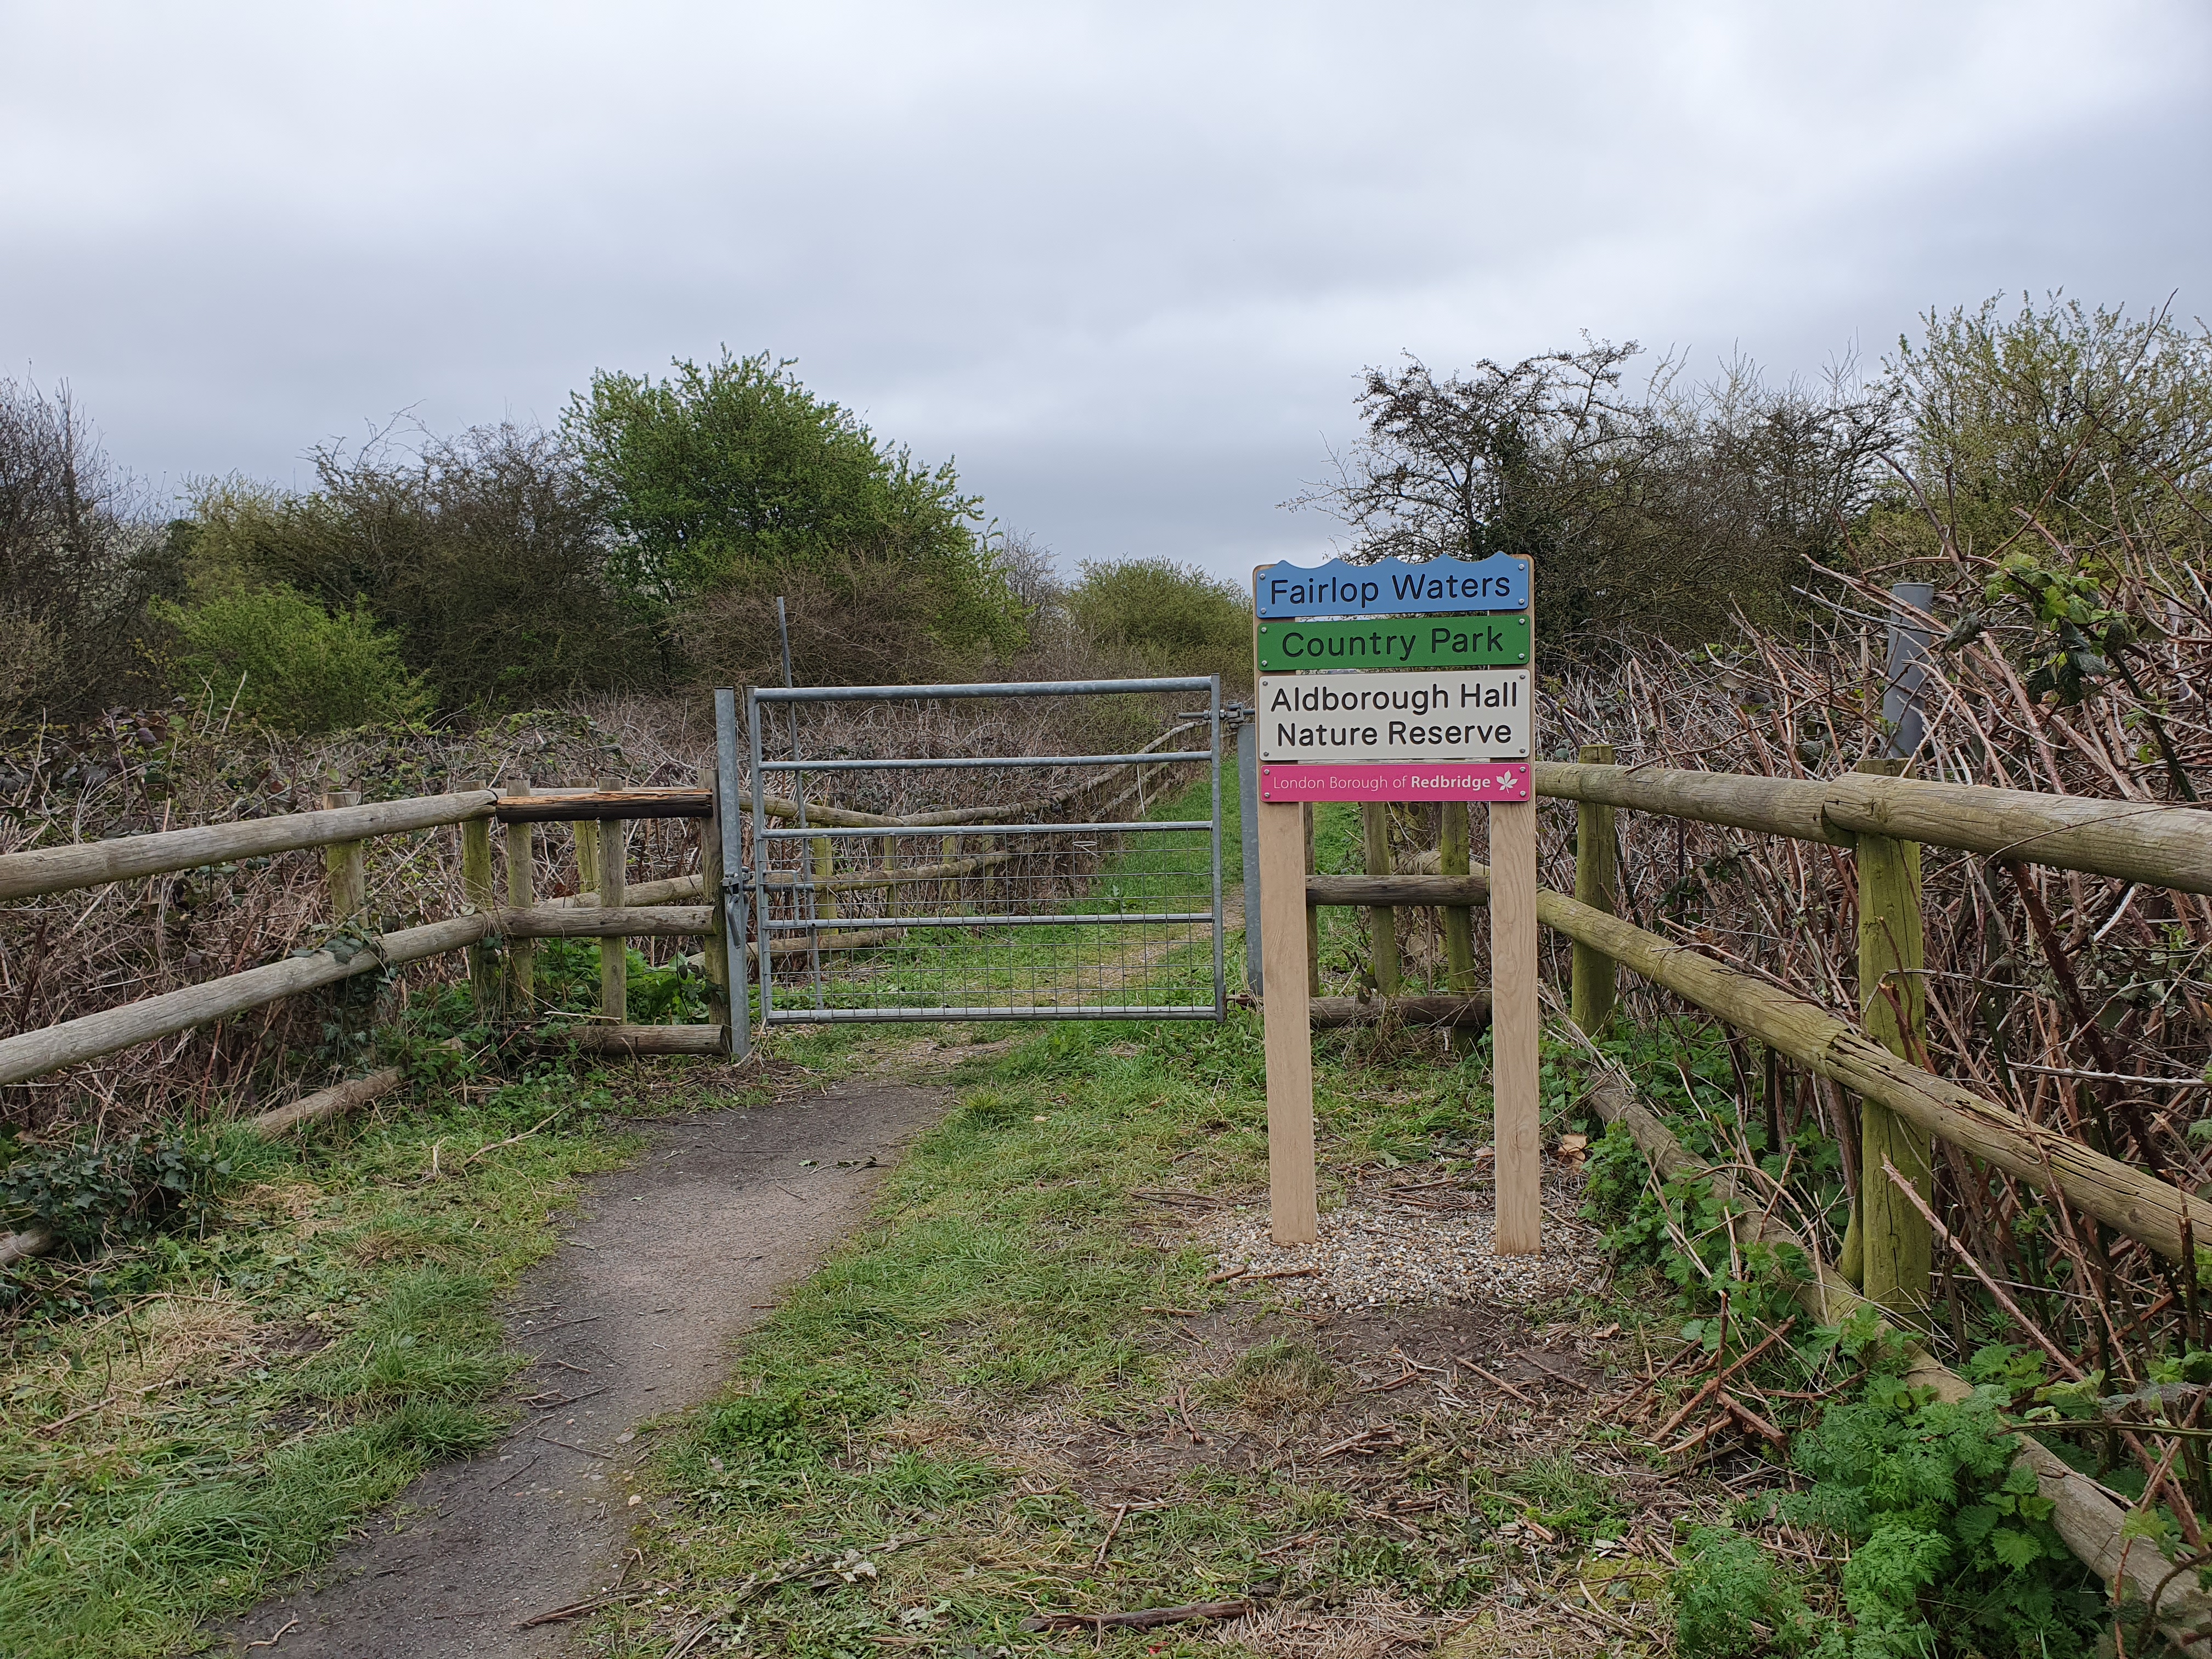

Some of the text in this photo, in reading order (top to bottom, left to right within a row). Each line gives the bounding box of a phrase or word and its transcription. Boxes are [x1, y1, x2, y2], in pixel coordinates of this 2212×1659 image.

[1271, 573, 1510, 608] Fairlop Waters
[1282, 625, 1503, 661] Country Park
[1270, 681, 1517, 715] Aldborough Hall
[1277, 721, 1511, 747] Nature Reserve
[1273, 774, 1491, 792] London Borough of Redbridge
